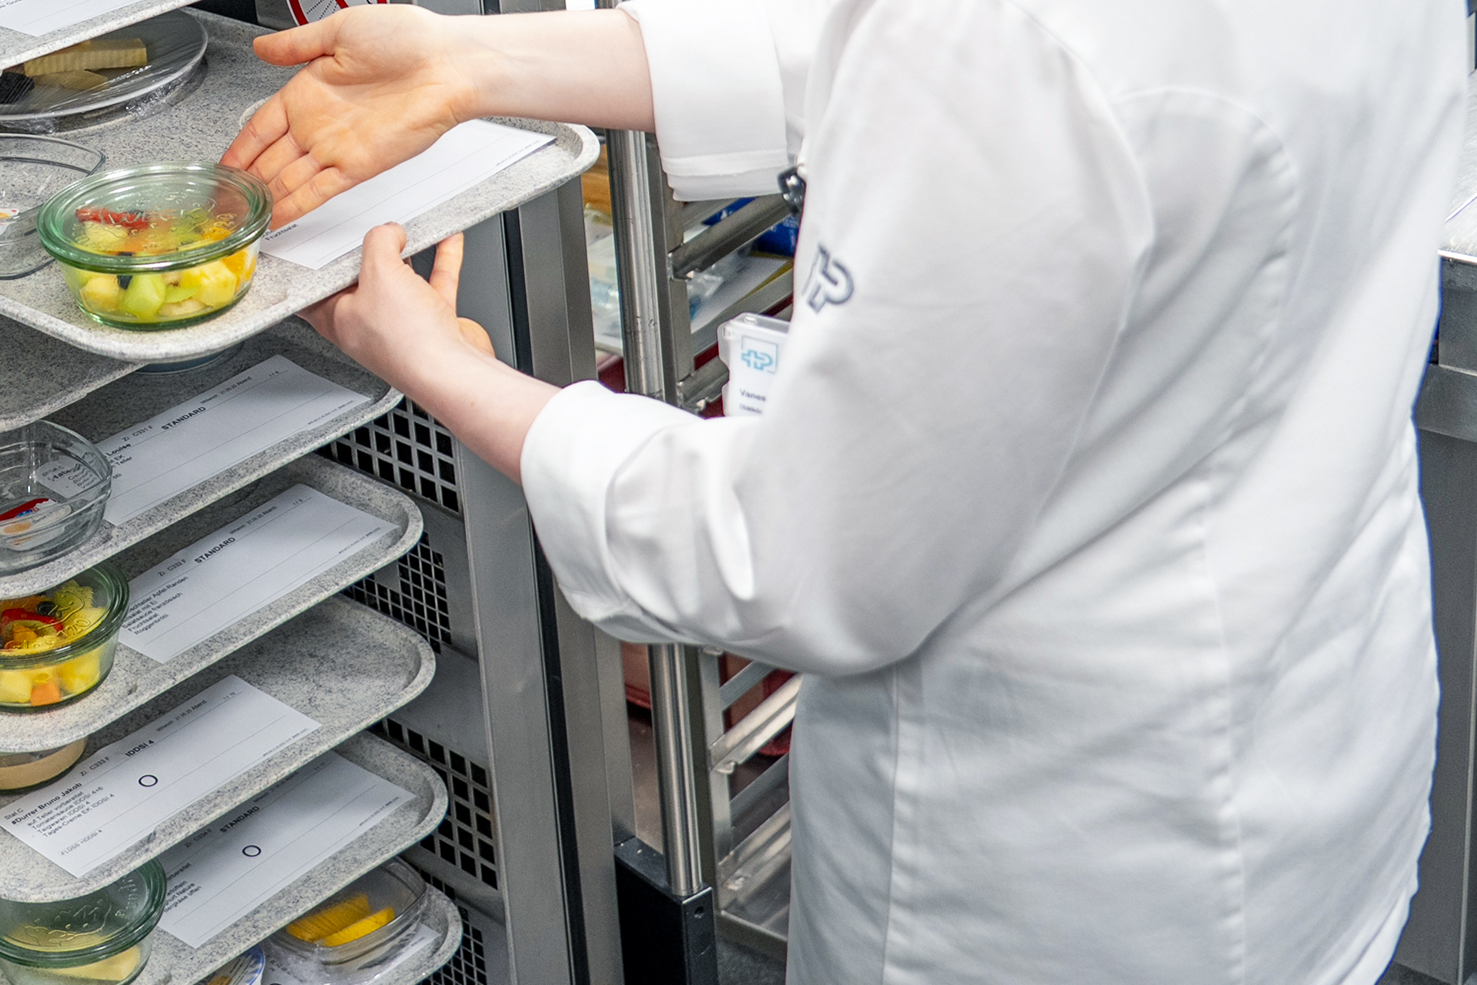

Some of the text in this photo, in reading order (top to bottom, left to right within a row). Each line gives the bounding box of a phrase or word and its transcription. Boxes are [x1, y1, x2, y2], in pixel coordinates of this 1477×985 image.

[740, 388, 766, 402] Vanes
[161, 406, 206, 429] STANDARD
[106, 443, 131, 456] Louise
[194, 537, 236, 563] STANDARD
[128, 613, 159, 631] Fruchtsalat
[125, 742, 148, 757] IDDSI
[89, 759, 106, 770] C333
[36, 810, 53, 820] Teller
[54, 791, 84, 810] vorbereitet
[38, 796, 60, 809] Bruno
[61, 783, 82, 796] Jakob
[32, 804, 74, 829] Tomatensauce
[73, 793, 91, 805] IDDSI
[37, 815, 68, 833] Teigwaren
[67, 804, 85, 815] IDDSI
[43, 813, 82, 837] Tages-Creme
[91, 796, 110, 808] IDDSI
[219, 806, 260, 832] STANDARD
[164, 862, 191, 880] orbereitet
[164, 881, 187, 895] artoffeln
